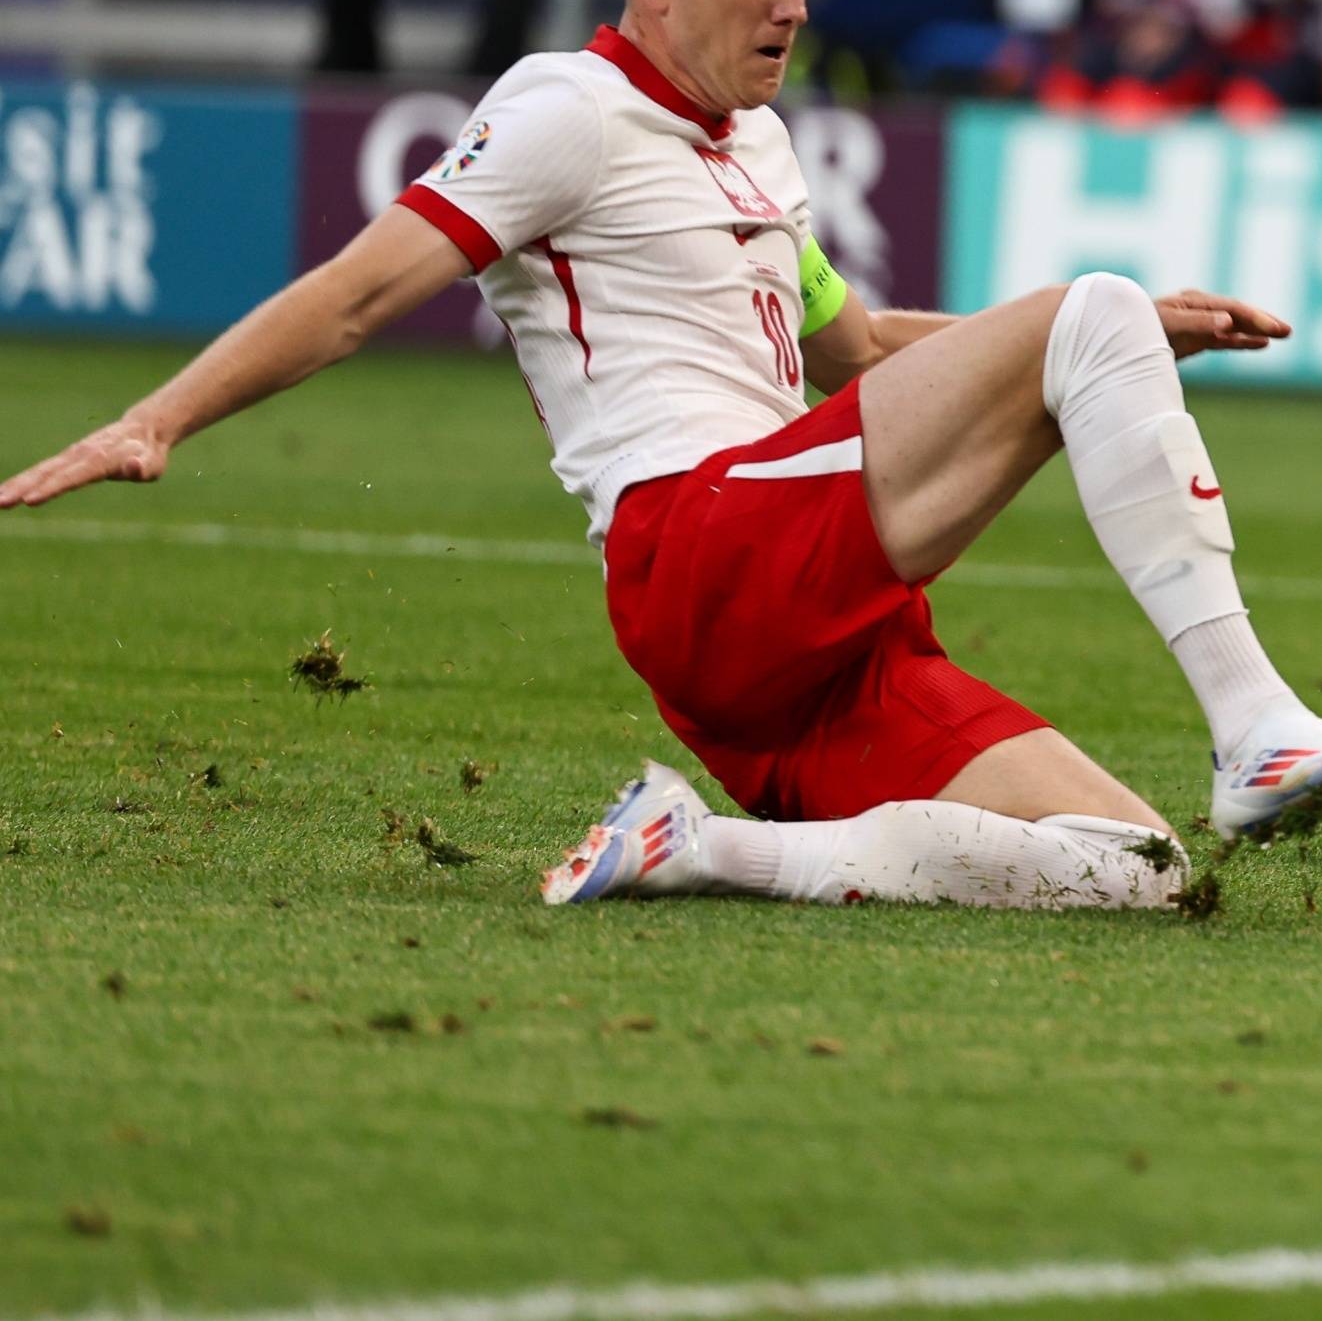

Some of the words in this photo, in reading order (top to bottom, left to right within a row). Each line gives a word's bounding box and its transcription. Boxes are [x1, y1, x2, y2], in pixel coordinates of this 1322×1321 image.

[2, 80, 160, 198] sit
[0, 190, 157, 315] AR
[752, 289, 799, 387] 10
